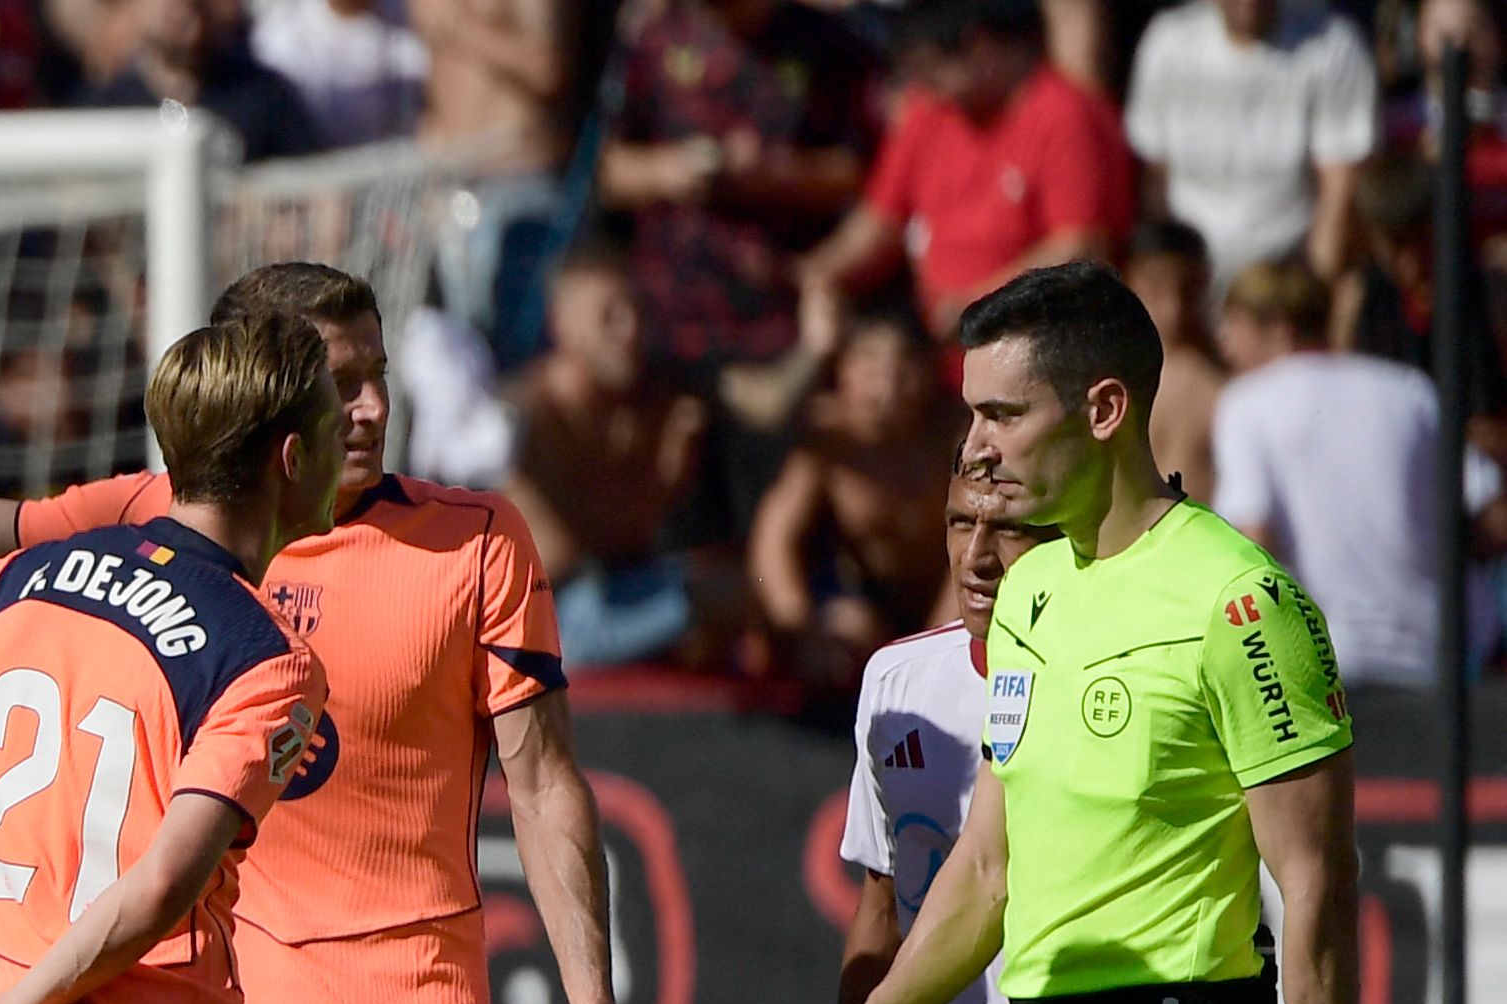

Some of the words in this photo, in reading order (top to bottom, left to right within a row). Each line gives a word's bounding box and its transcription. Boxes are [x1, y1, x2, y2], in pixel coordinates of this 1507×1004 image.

[993, 675, 1026, 697] FIFA
[1242, 630, 1298, 743] WÜRTH
[990, 713, 1022, 725] REFEREE
